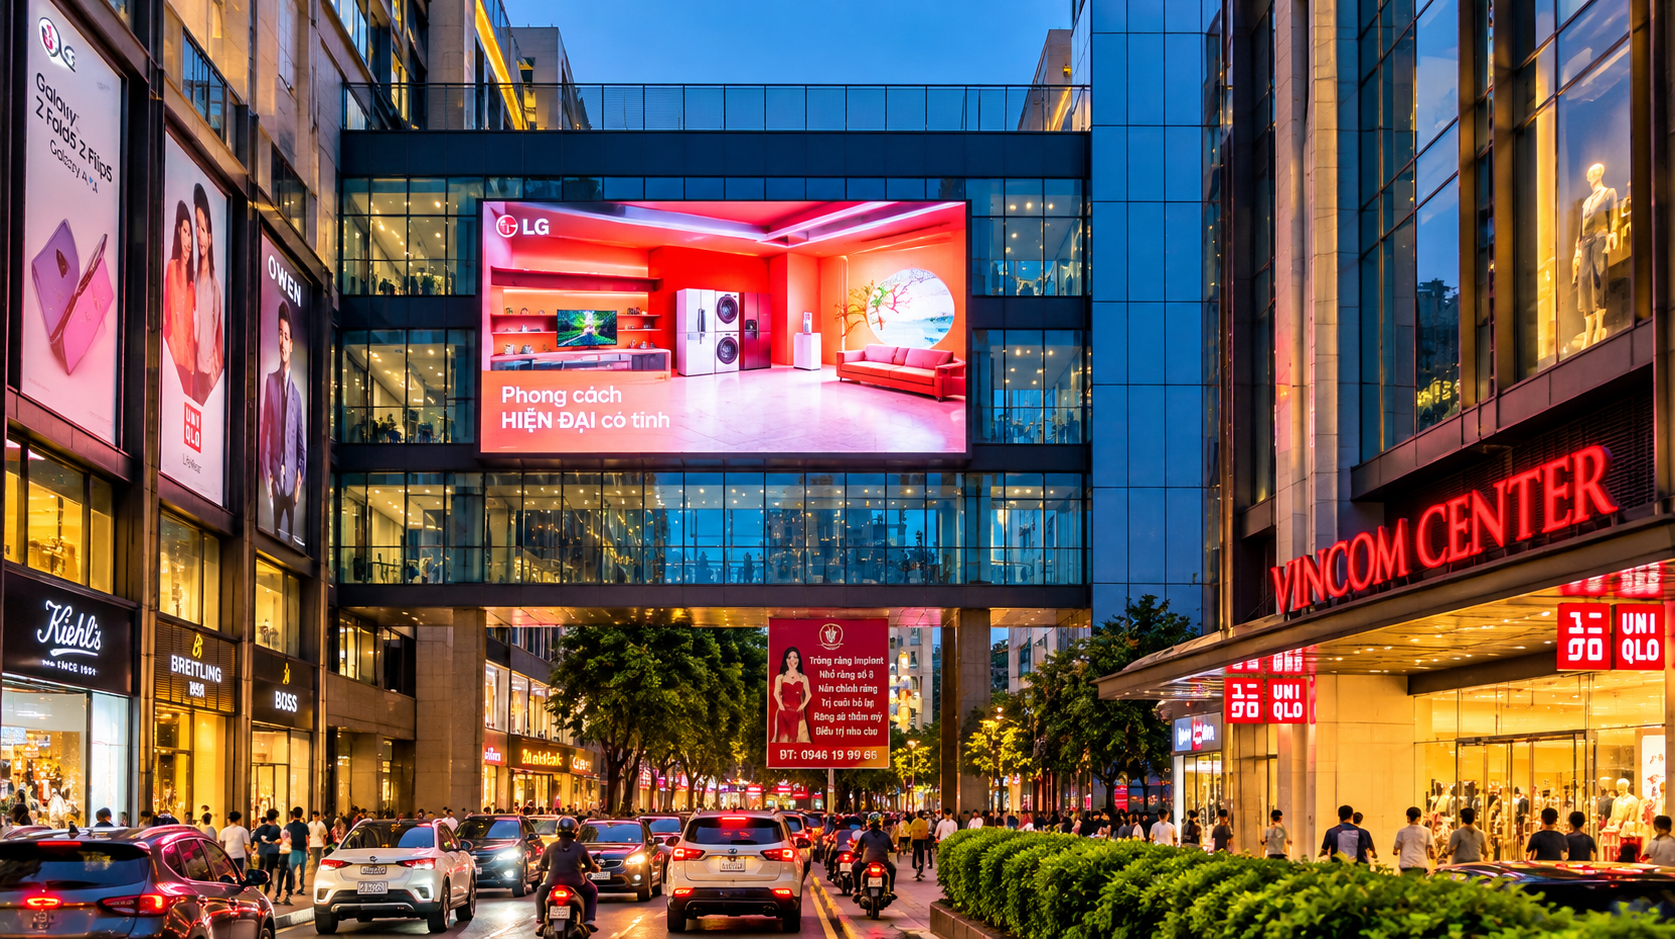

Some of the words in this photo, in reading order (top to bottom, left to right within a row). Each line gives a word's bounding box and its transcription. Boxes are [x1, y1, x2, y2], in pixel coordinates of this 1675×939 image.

[522, 218, 550, 236] LG
[268, 254, 302, 307] OWEN
[502, 386, 567, 408] Phong
[557, 411, 596, 434] ĐẠI
[1271, 518, 1413, 615] VINCOM
[1416, 445, 1618, 568] CENTER
[37, 600, 102, 651] Kiehl's
[1622, 612, 1656, 635] UNI
[1621, 638, 1660, 664] QLO
[171, 654, 222, 683] BREITLING
[275, 690, 297, 713] BOSS
[1273, 684, 1300, 700] UNI
[1273, 702, 1303, 721] QLO
[801, 749, 828, 760] 0946
[831, 750, 844, 760] 19
[863, 750, 878, 760] 66
